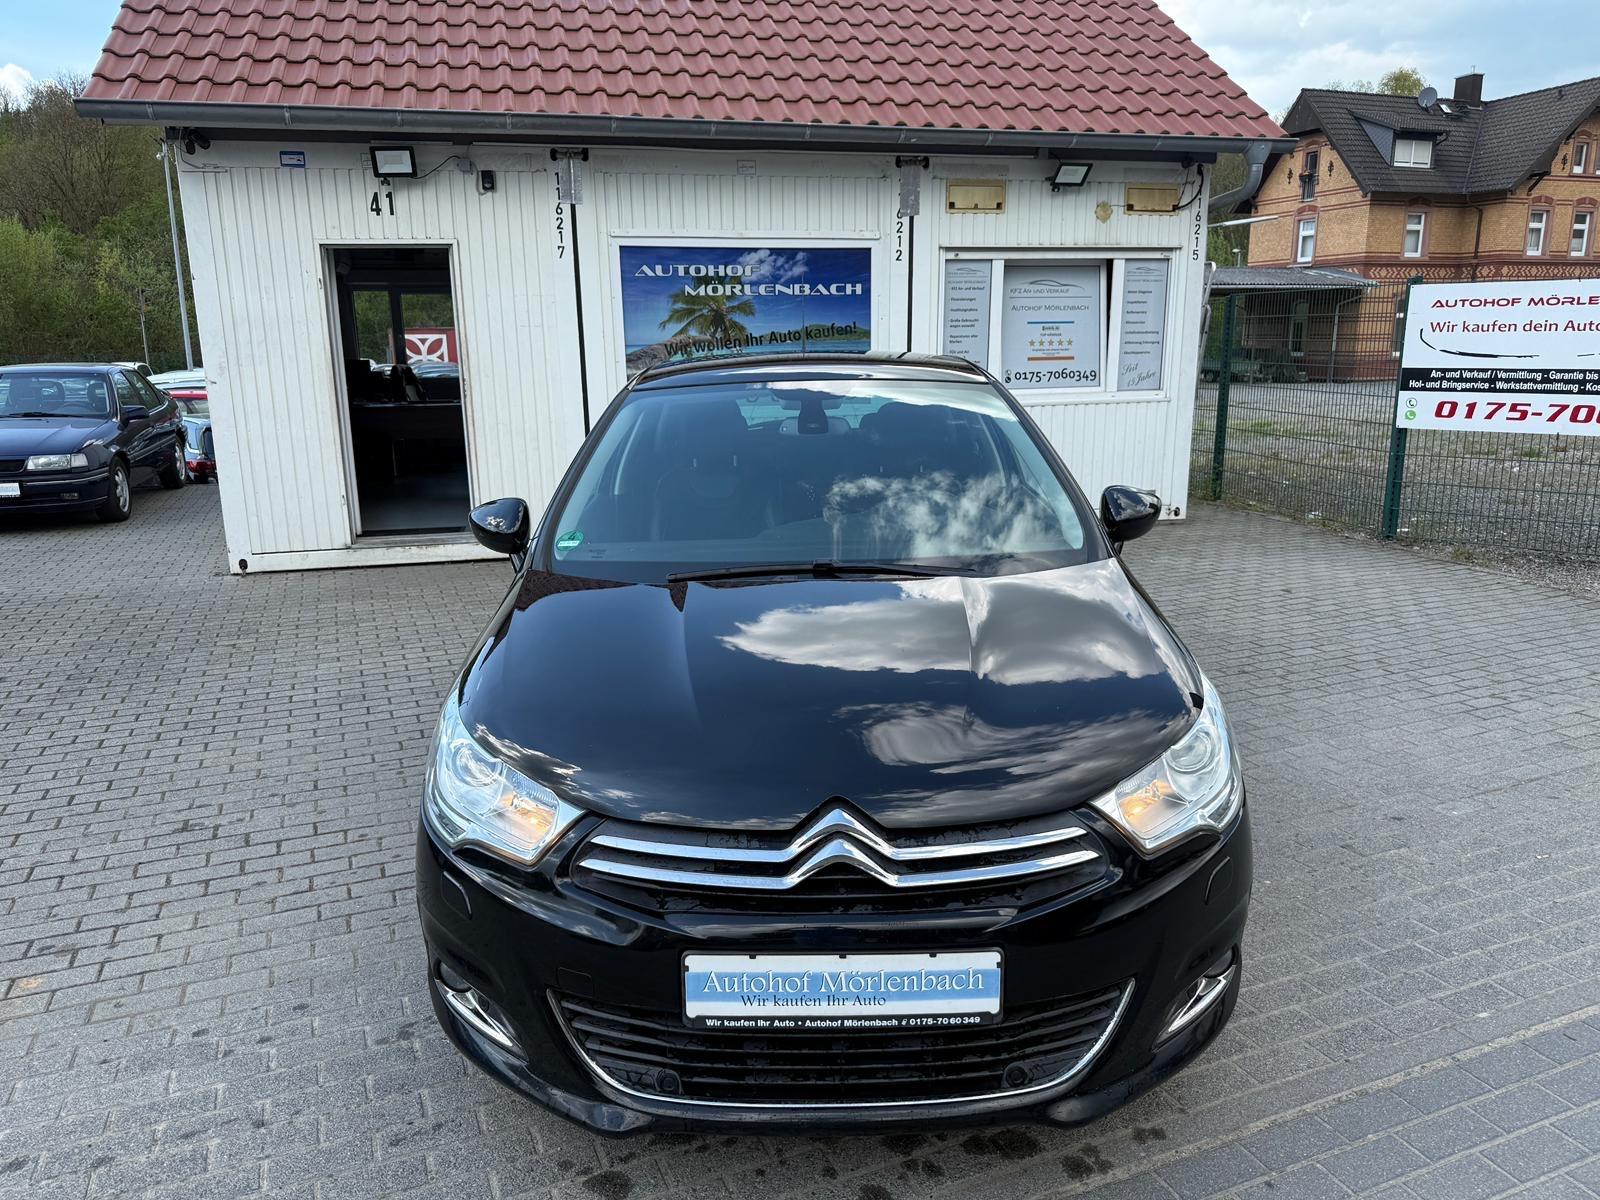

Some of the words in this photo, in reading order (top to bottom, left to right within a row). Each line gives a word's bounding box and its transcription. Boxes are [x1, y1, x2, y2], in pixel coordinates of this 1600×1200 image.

[370, 191, 395, 216] 41
[634, 264, 762, 277] AUTOHOF
[684, 280, 862, 296] MÖRLENBACH
[1431, 297, 1522, 308] AUTOHOF
[1528, 294, 1600, 307] MÖRLE
[1430, 321, 1457, 333] Wir
[1462, 320, 1517, 333] kaufen
[1522, 319, 1559, 332] dein
[1563, 319, 1600, 332] Auto
[664, 341, 691, 356] Wir
[693, 336, 742, 353] wollen
[745, 332, 765, 348] Ihr
[768, 328, 801, 344] Auto
[805, 321, 857, 340] kaufen!
[1014, 368, 1097, 382] 0175-7060349
[1430, 370, 1444, 378] An-
[1445, 370, 1460, 378] und
[1461, 370, 1491, 379] Verkauf
[1497, 371, 1542, 381] Vermittlung
[1549, 371, 1584, 380] Garantie
[1586, 371, 1599, 380] bis
[1409, 380, 1425, 388] Hol-
[1441, 380, 1489, 390] Bringservice
[1496, 381, 1579, 392] Werkstattvermittlung
[1434, 400, 1600, 424] 0175-70
[702, 969, 813, 993] Autohof
[820, 968, 984, 993] Mörlenbach
[740, 995, 768, 1007] Wir
[772, 995, 823, 1007] kaufen
[827, 995, 848, 1007] Ihr
[851, 994, 886, 1007] Auto
[705, 1019, 723, 1027] Wir
[724, 1019, 755, 1027] kaufen
[757, 1019, 771, 1027] Ihr
[773, 1018, 795, 1027] Auto
[804, 1018, 842, 1027] Autohof
[844, 1017, 898, 1027] Mörlenbach
